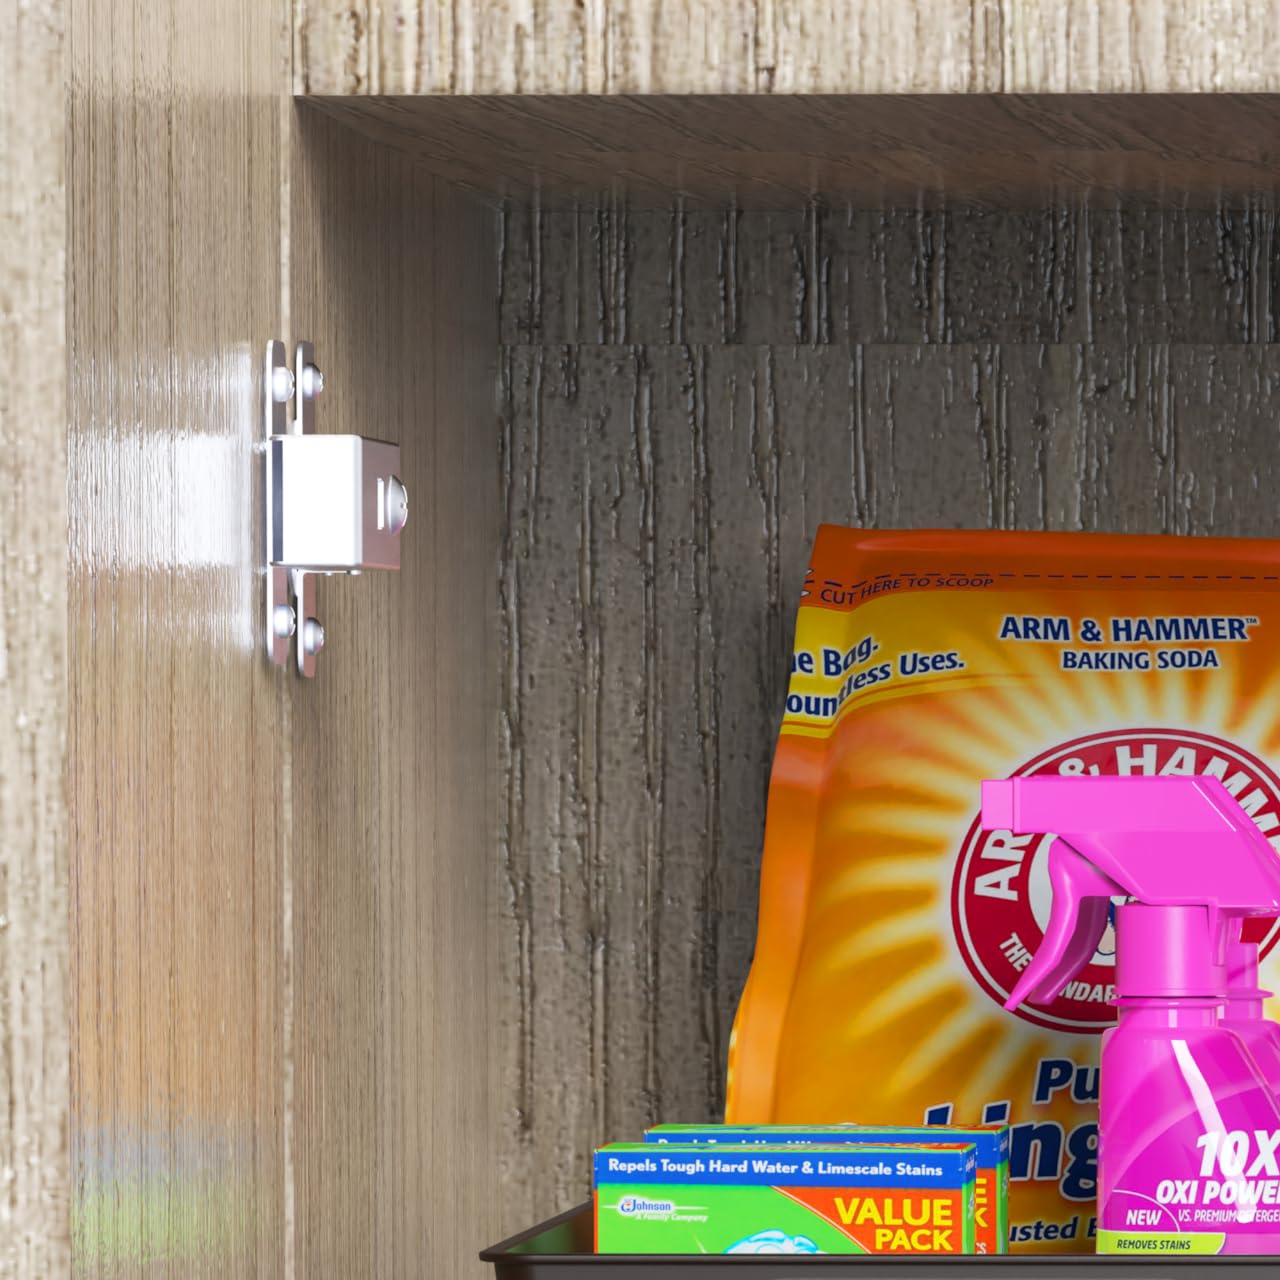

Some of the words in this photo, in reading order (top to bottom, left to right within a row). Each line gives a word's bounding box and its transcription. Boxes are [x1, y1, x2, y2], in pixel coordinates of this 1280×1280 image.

[820, 588, 857, 605] CUT
[861, 578, 901, 599] HERE
[909, 577, 931, 588] TO
[936, 577, 994, 588] SCOOP
[1000, 616, 1071, 641] ARM
[1080, 619, 1102, 642] &
[823, 636, 879, 677] Bag.
[1062, 651, 1150, 670] BAKING
[1157, 649, 1219, 669] SODA
[786, 663, 891, 717] ountless
[899, 651, 965, 676] Uses.
[974, 829, 1035, 901] AR
[998, 931, 1034, 973] THE
[1058, 980, 1119, 1004] NDAR
[1034, 1058, 1100, 1103] Pu
[608, 1157, 657, 1174] Repels
[660, 1158, 705, 1175] Tough
[709, 1159, 748, 1173] Hard
[751, 1160, 799, 1174] Water
[801, 1161, 814, 1174] &
[818, 1161, 893, 1176] Limescale
[896, 1162, 944, 1176] Stains
[1155, 1179, 1199, 1205] OXI
[834, 1197, 953, 1226] VALUE
[1125, 1209, 1162, 1226] NEW
[1178, 1208, 1193, 1222] VS.
[1194, 1208, 1237, 1222] PREMIUM
[875, 1229, 953, 1251] PACK
[1116, 1239, 1158, 1250] REMOVES
[1159, 1239, 1191, 1251] STAINS
